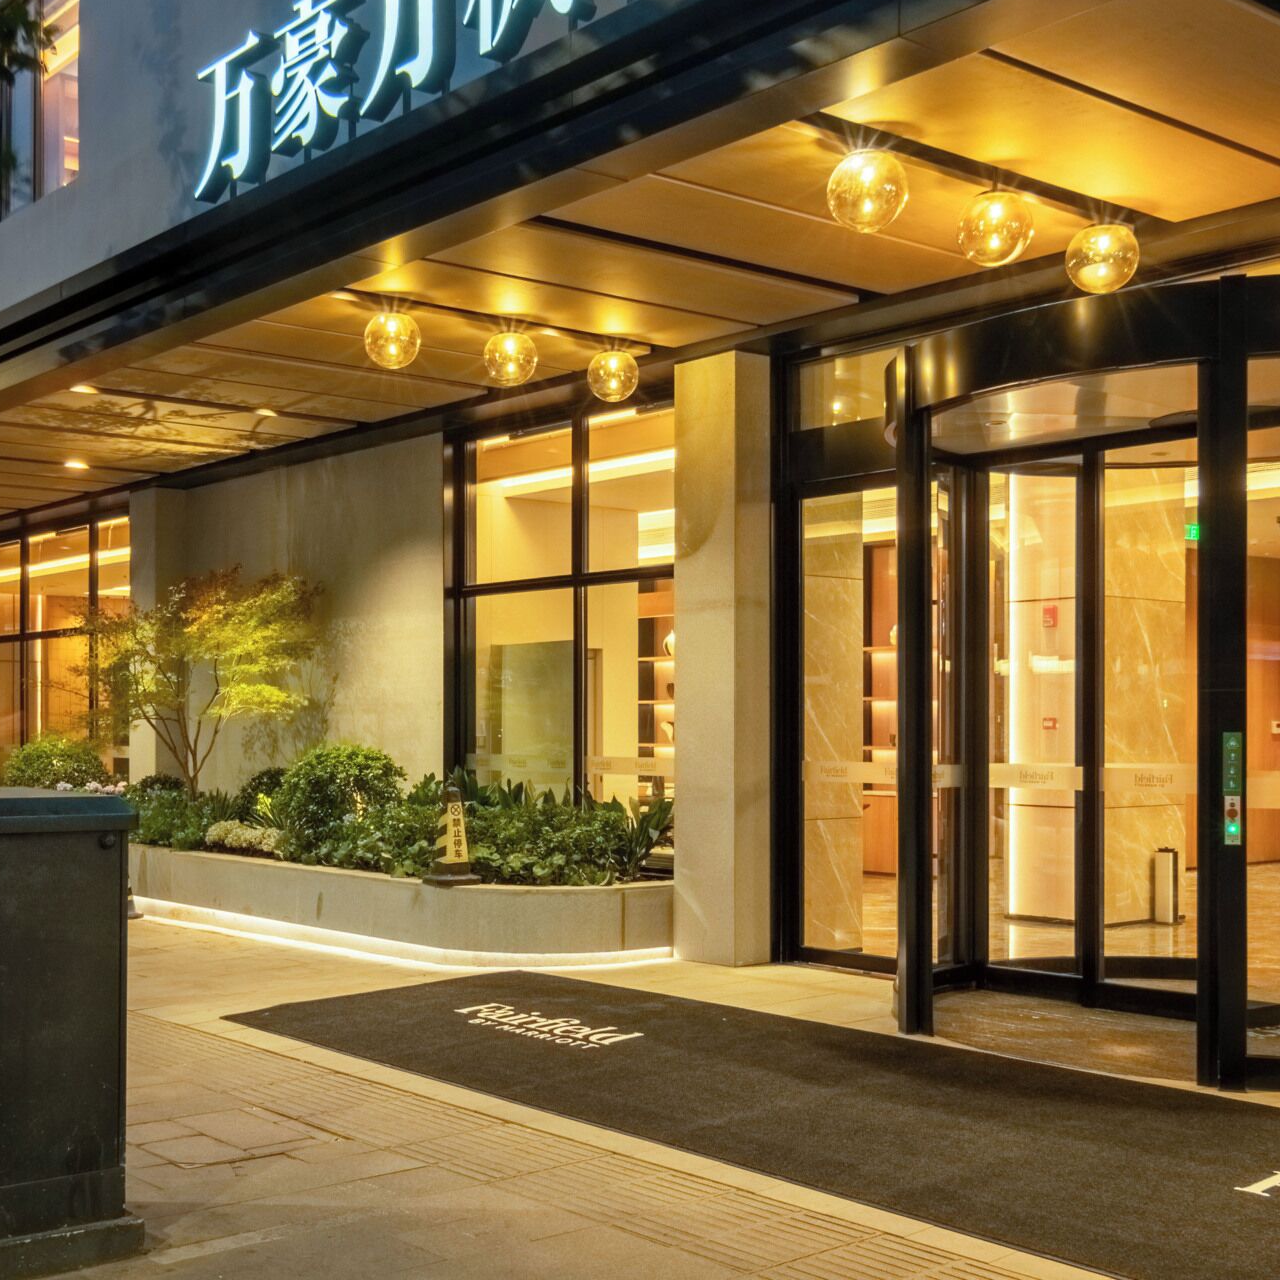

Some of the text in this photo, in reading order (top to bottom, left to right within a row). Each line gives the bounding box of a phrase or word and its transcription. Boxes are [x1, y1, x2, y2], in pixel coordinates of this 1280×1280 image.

[452, 818, 463, 859] 禁止停车
[454, 1002, 645, 1046] Fairfield
[468, 1018, 600, 1049] BY MARRIOTT
